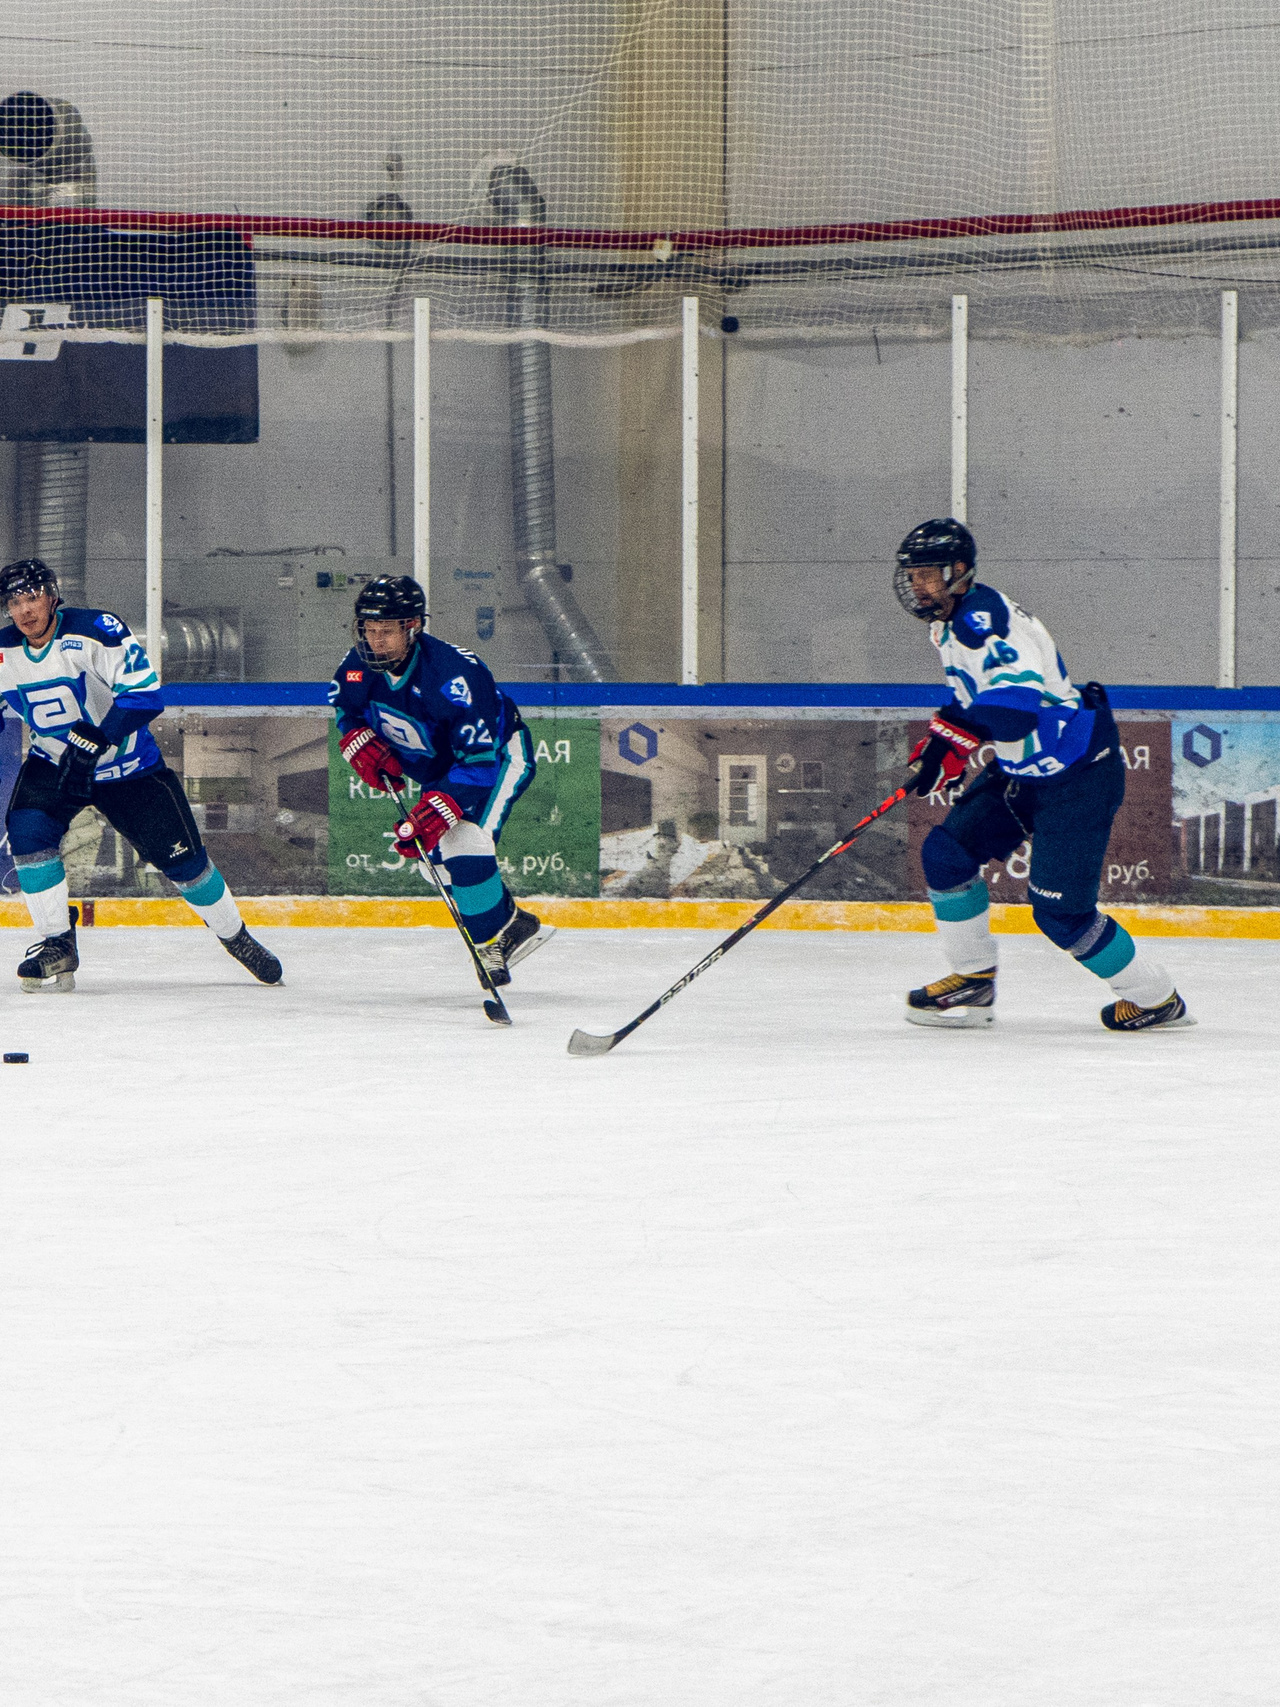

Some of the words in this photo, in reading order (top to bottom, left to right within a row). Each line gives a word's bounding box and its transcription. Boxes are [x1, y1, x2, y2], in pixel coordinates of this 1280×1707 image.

[67, 729, 99, 754] RIOR
[346, 853, 372, 868] от
[523, 852, 571, 876] руб.
[1107, 859, 1155, 885] руб.
